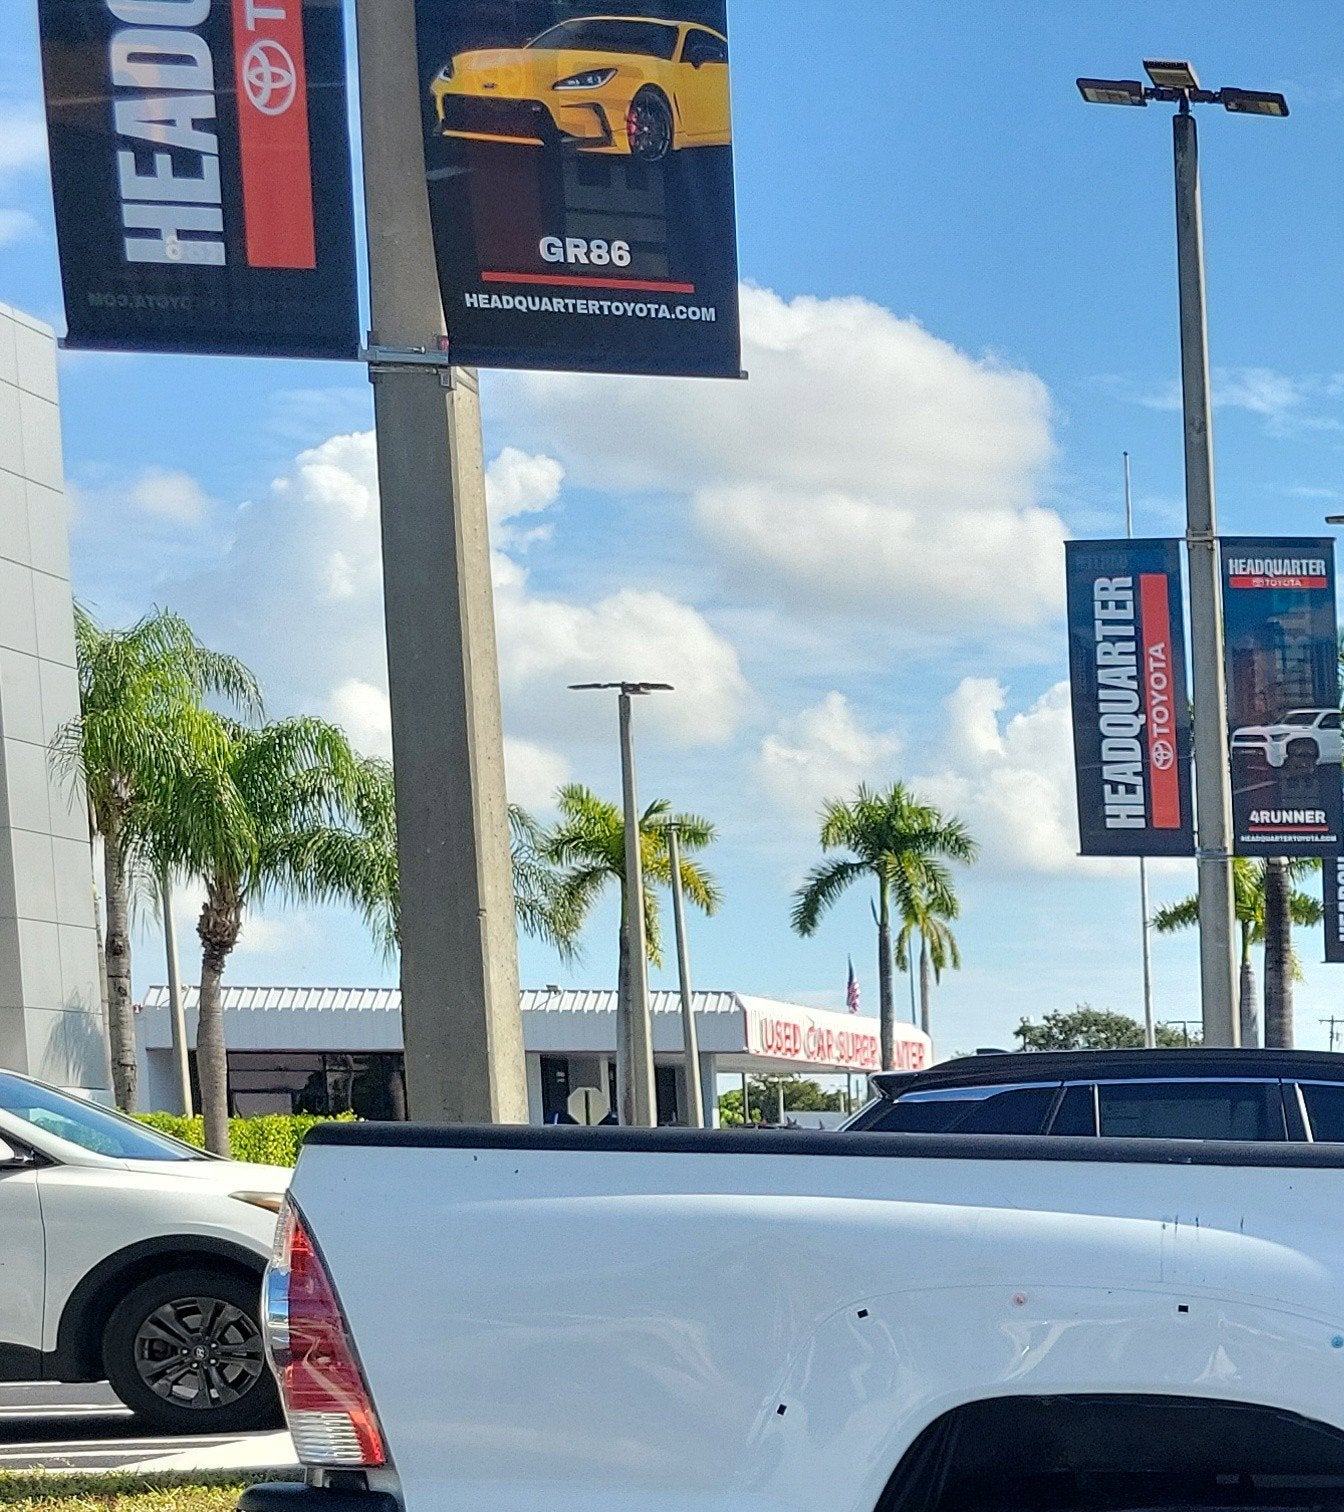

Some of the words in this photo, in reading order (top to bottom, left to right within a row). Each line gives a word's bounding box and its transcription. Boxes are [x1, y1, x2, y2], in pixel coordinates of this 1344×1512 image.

[538, 235, 632, 268] GR86
[464, 292, 717, 323] HEADQUARTERTOYOTA.COM
[1228, 557, 1326, 578] HEADQUARTER
[1093, 575, 1147, 829] HEADQUARTER
[1149, 641, 1171, 738] TOYOTA
[1249, 809, 1327, 824] 4RUNNER
[764, 1018, 801, 1055] USED
[805, 1026, 834, 1061] CAR
[892, 1040, 925, 1069] NTER
